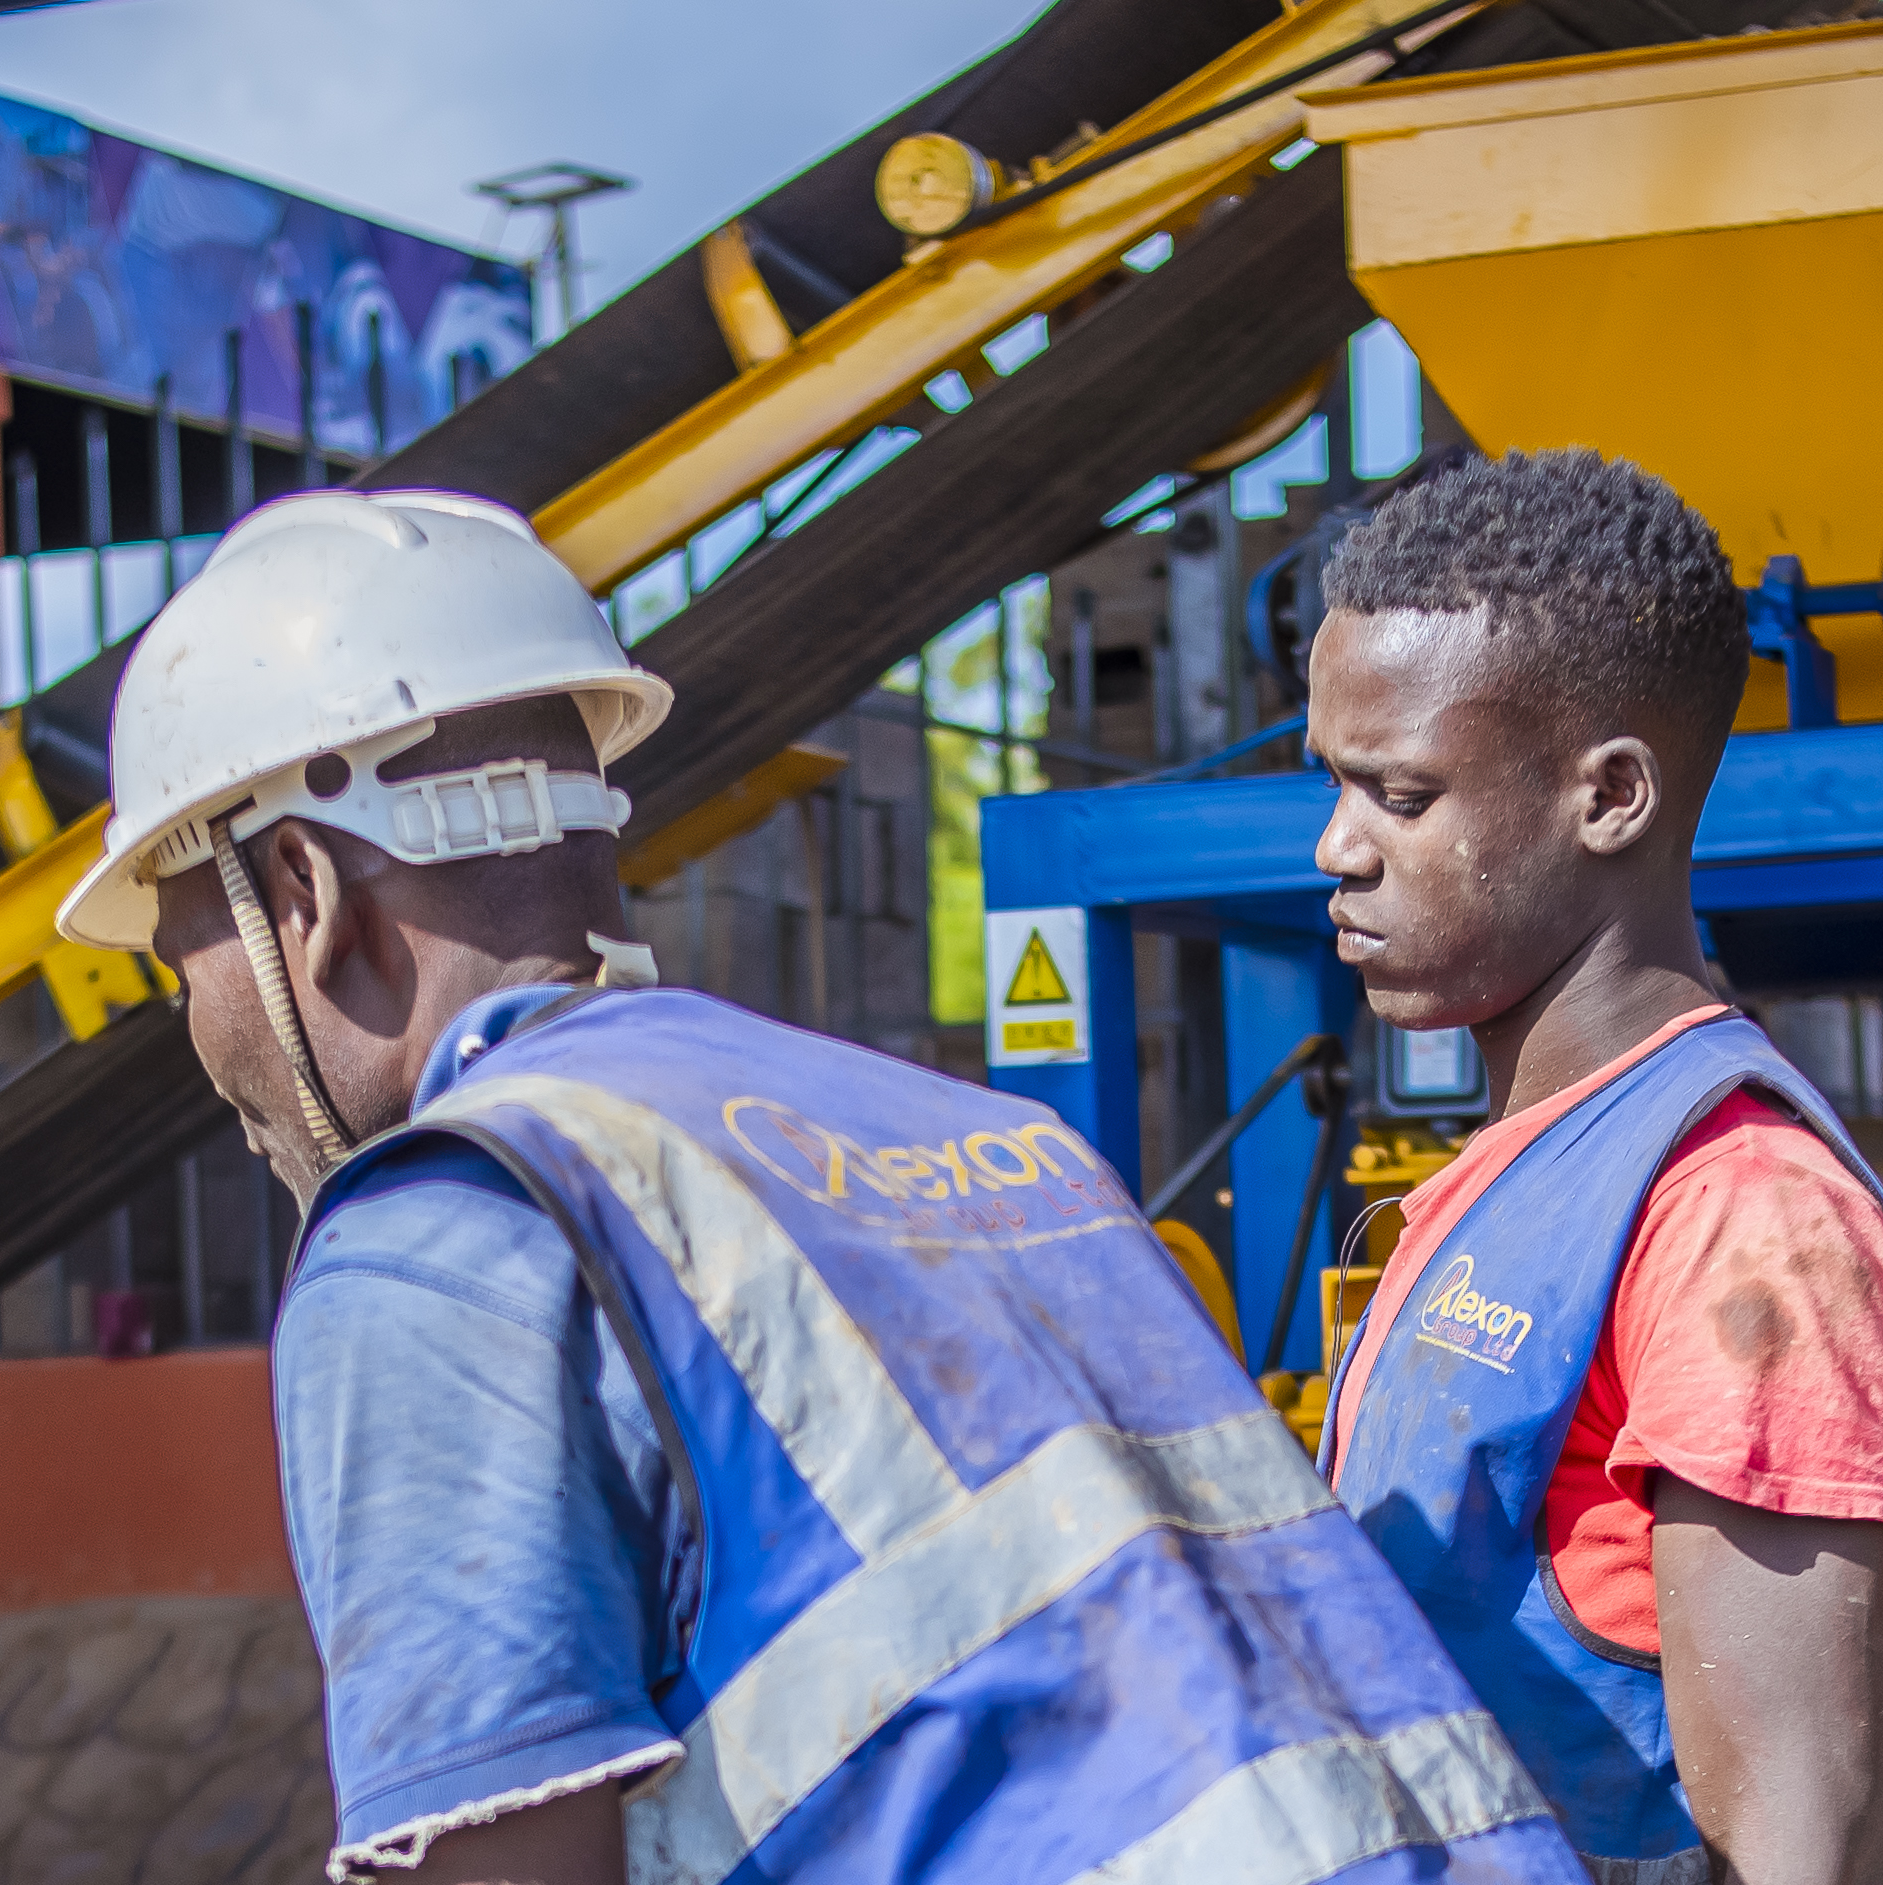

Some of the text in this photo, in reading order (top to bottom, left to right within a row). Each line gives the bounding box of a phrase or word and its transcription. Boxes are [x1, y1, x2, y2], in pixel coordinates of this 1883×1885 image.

[1421, 1254, 1533, 1346] Alexon
[1431, 1315, 1477, 1348] Group
[1482, 1334, 1520, 1361] Ltd
